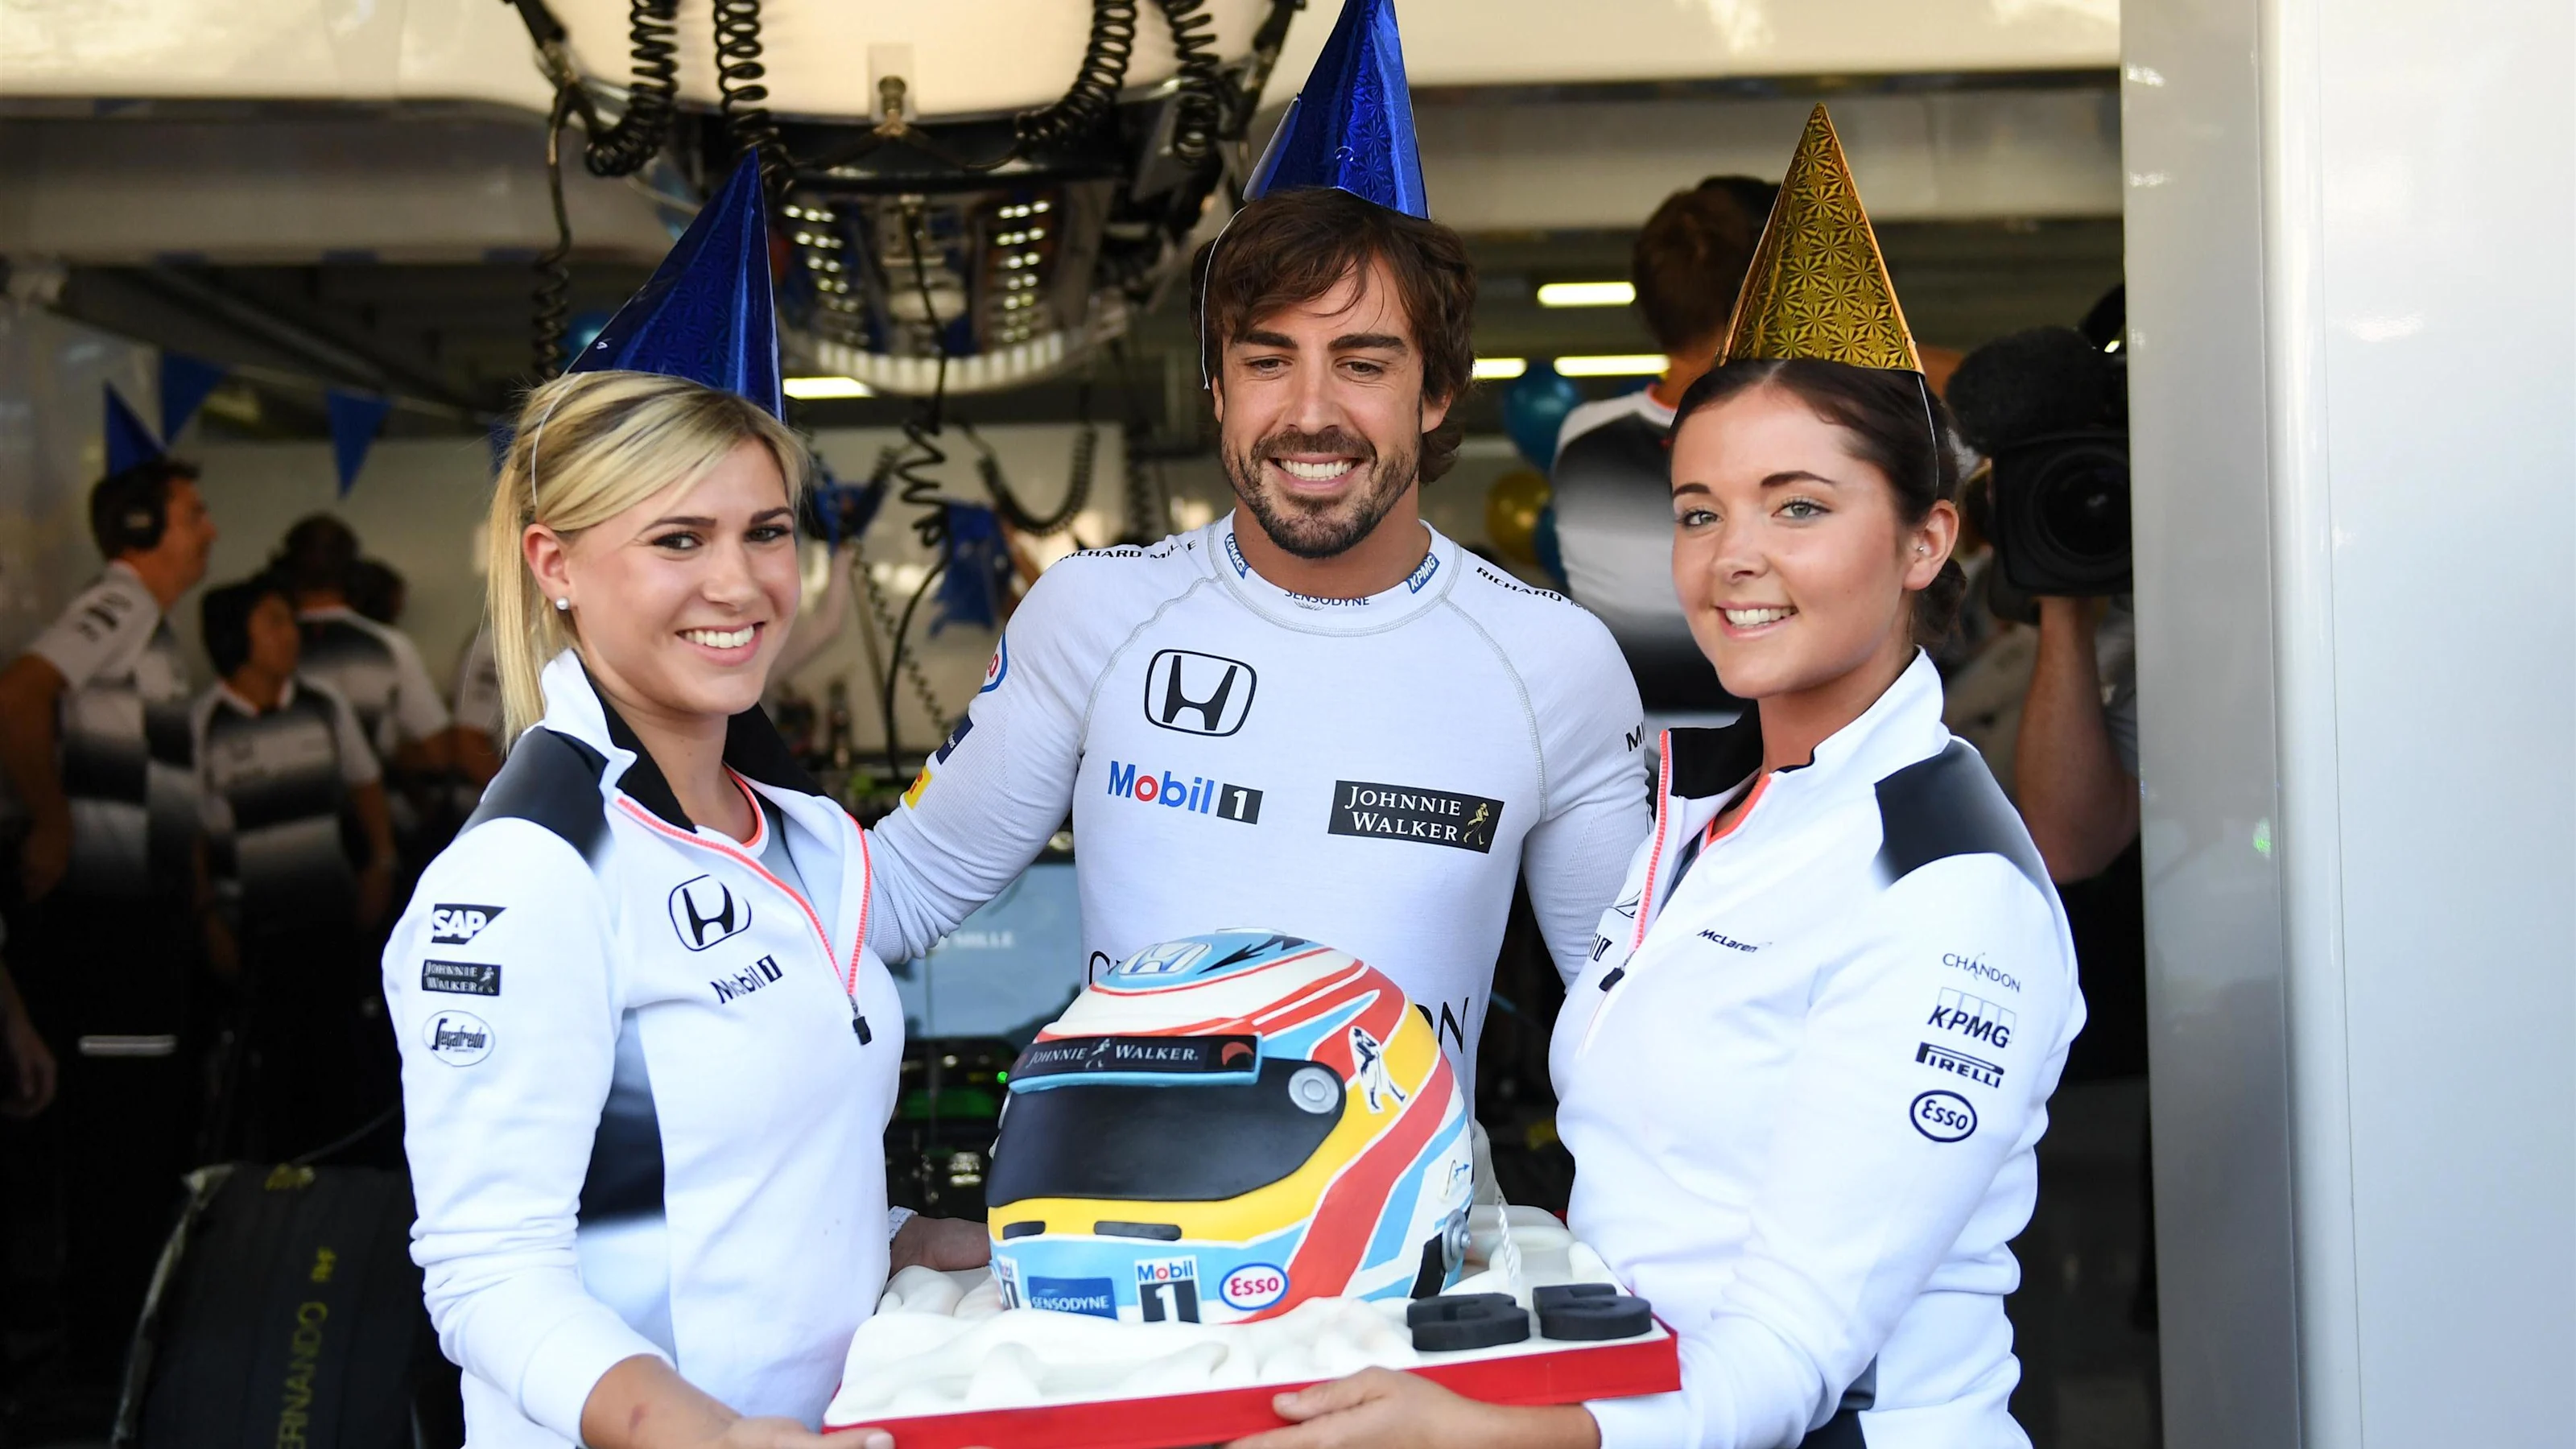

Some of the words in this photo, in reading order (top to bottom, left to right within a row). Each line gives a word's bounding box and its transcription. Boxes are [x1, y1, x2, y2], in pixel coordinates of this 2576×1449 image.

[1224, 535, 1245, 572] KPMG
[1409, 555, 1437, 592] KPMG
[1476, 567, 1562, 602] RICHARD
[1108, 760, 1215, 815] Mobil
[1344, 785, 1463, 816] JOHNNIE
[1352, 811, 1459, 842] WALKER
[432, 909, 487, 939] SAP
[1697, 928, 1758, 953] McLaren
[424, 960, 478, 977] JOHNNIE
[1942, 952, 2021, 993] CHANDON
[425, 976, 478, 993] WALKER
[710, 964, 766, 1005] Mobil
[1927, 1005, 2011, 1049] KPMG
[1026, 1046, 1088, 1069] JOHNNIE
[1915, 1042, 2004, 1088] PIRELLI
[1137, 1260, 1194, 1282] Mobil
[1031, 1294, 1110, 1312] SENSODYNE
